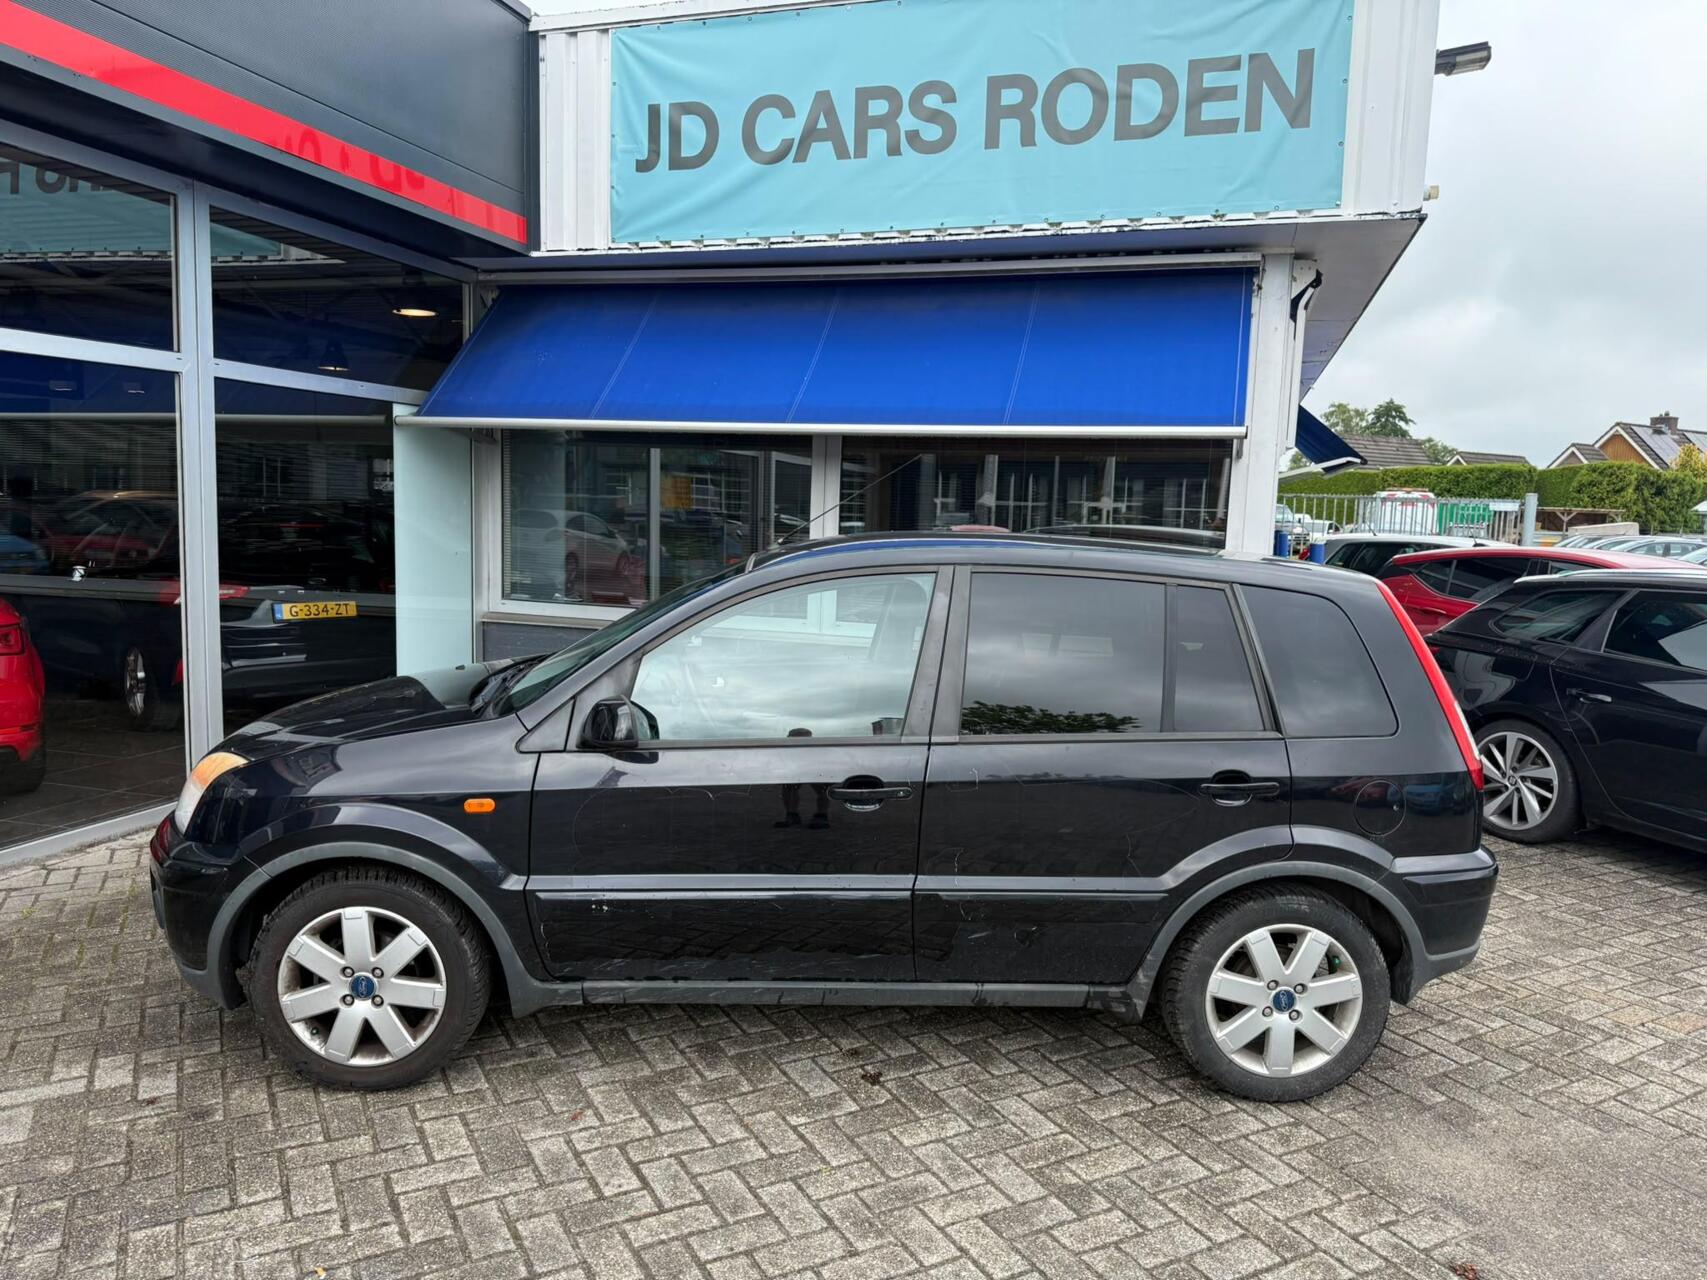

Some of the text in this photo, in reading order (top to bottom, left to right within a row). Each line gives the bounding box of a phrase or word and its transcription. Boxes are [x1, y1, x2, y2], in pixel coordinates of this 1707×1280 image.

[635, 48, 1315, 173] JD CARS RODEN
[289, 603, 349, 617] G-334-ZT
